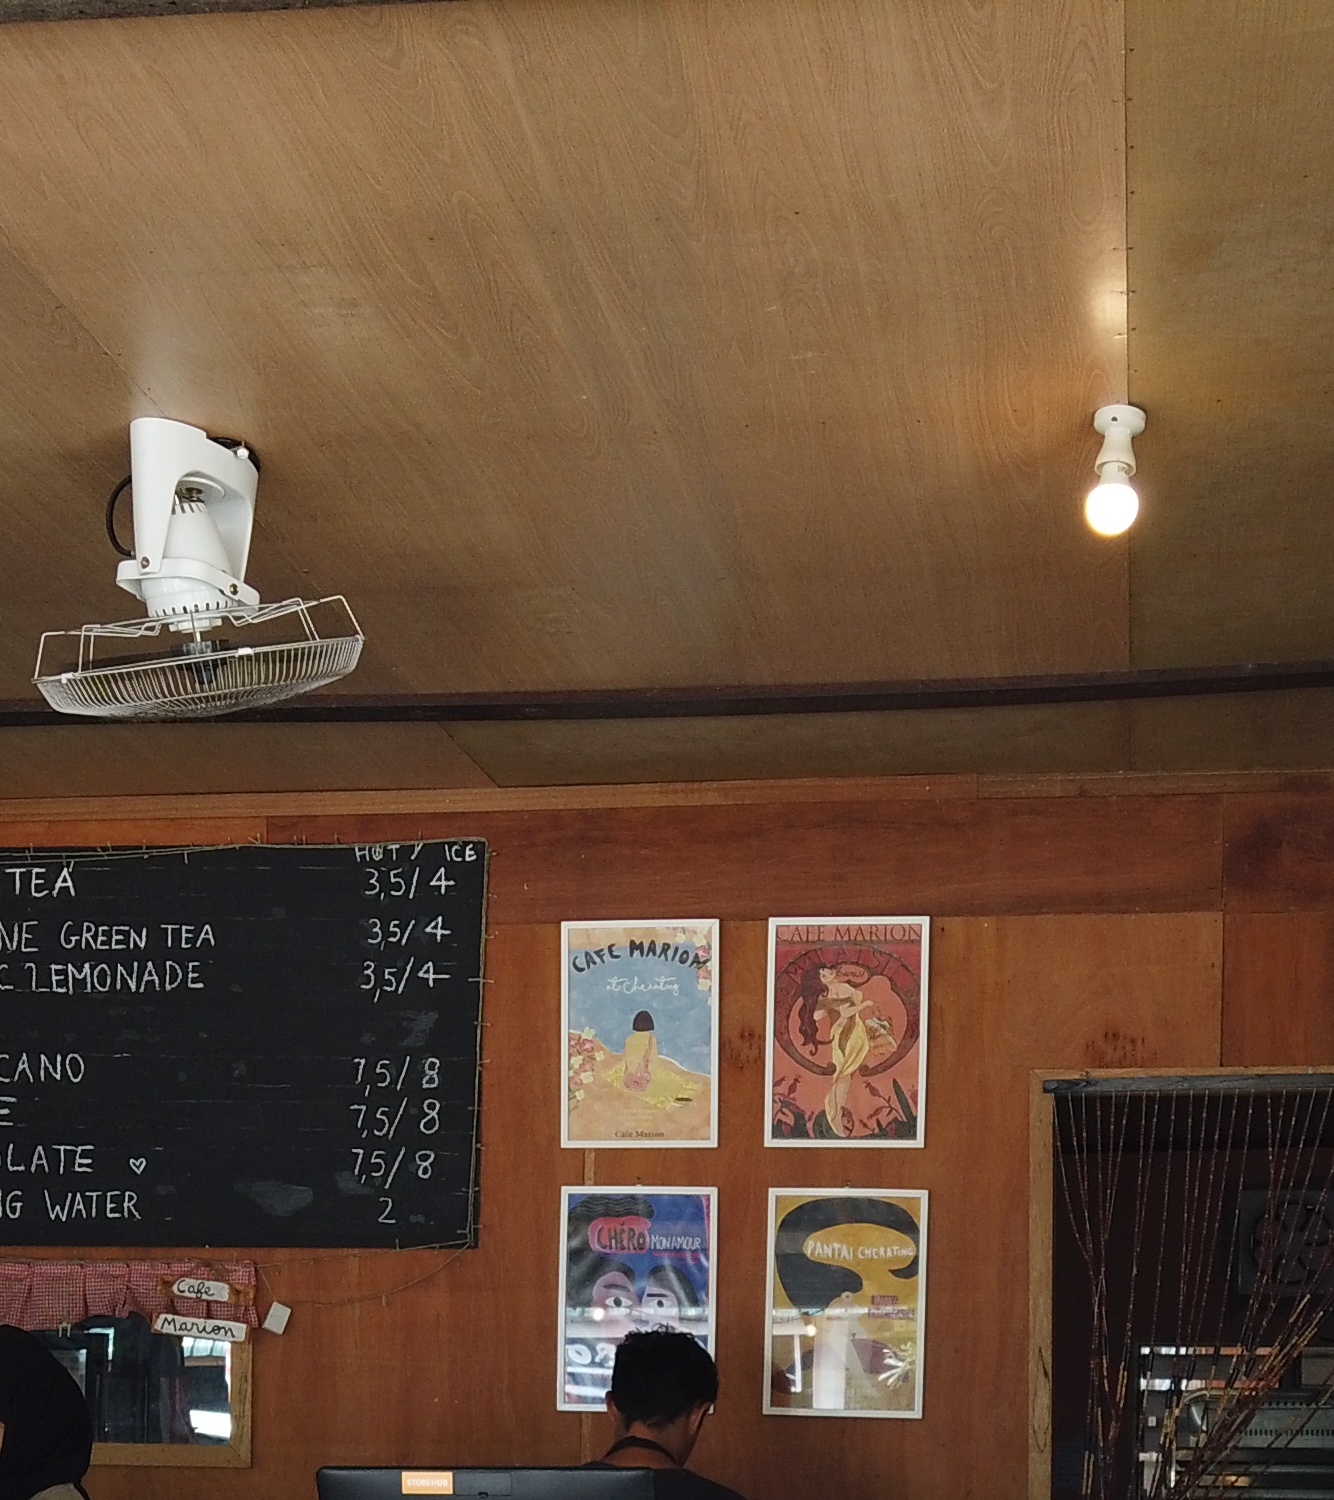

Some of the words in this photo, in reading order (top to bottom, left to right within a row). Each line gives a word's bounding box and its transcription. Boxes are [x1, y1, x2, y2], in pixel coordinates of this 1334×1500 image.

[354, 844, 400, 862] HOT
[444, 843, 477, 861] ICE
[5, 866, 77, 898] TEA
[60, 920, 147, 950] GREEN
[160, 923, 215, 949] TEA
[572, 942, 622, 973] CAFE
[25, 960, 205, 996] LEMONADE
[44, 1189, 142, 1222] WATER
[377, 1197, 396, 1224] 2
[806, 1239, 854, 1262] PANTAI
[176, 1278, 215, 1299] Cafe
[160, 1316, 236, 1339] Marion
[406, 1478, 448, 1488] STOREHUB
